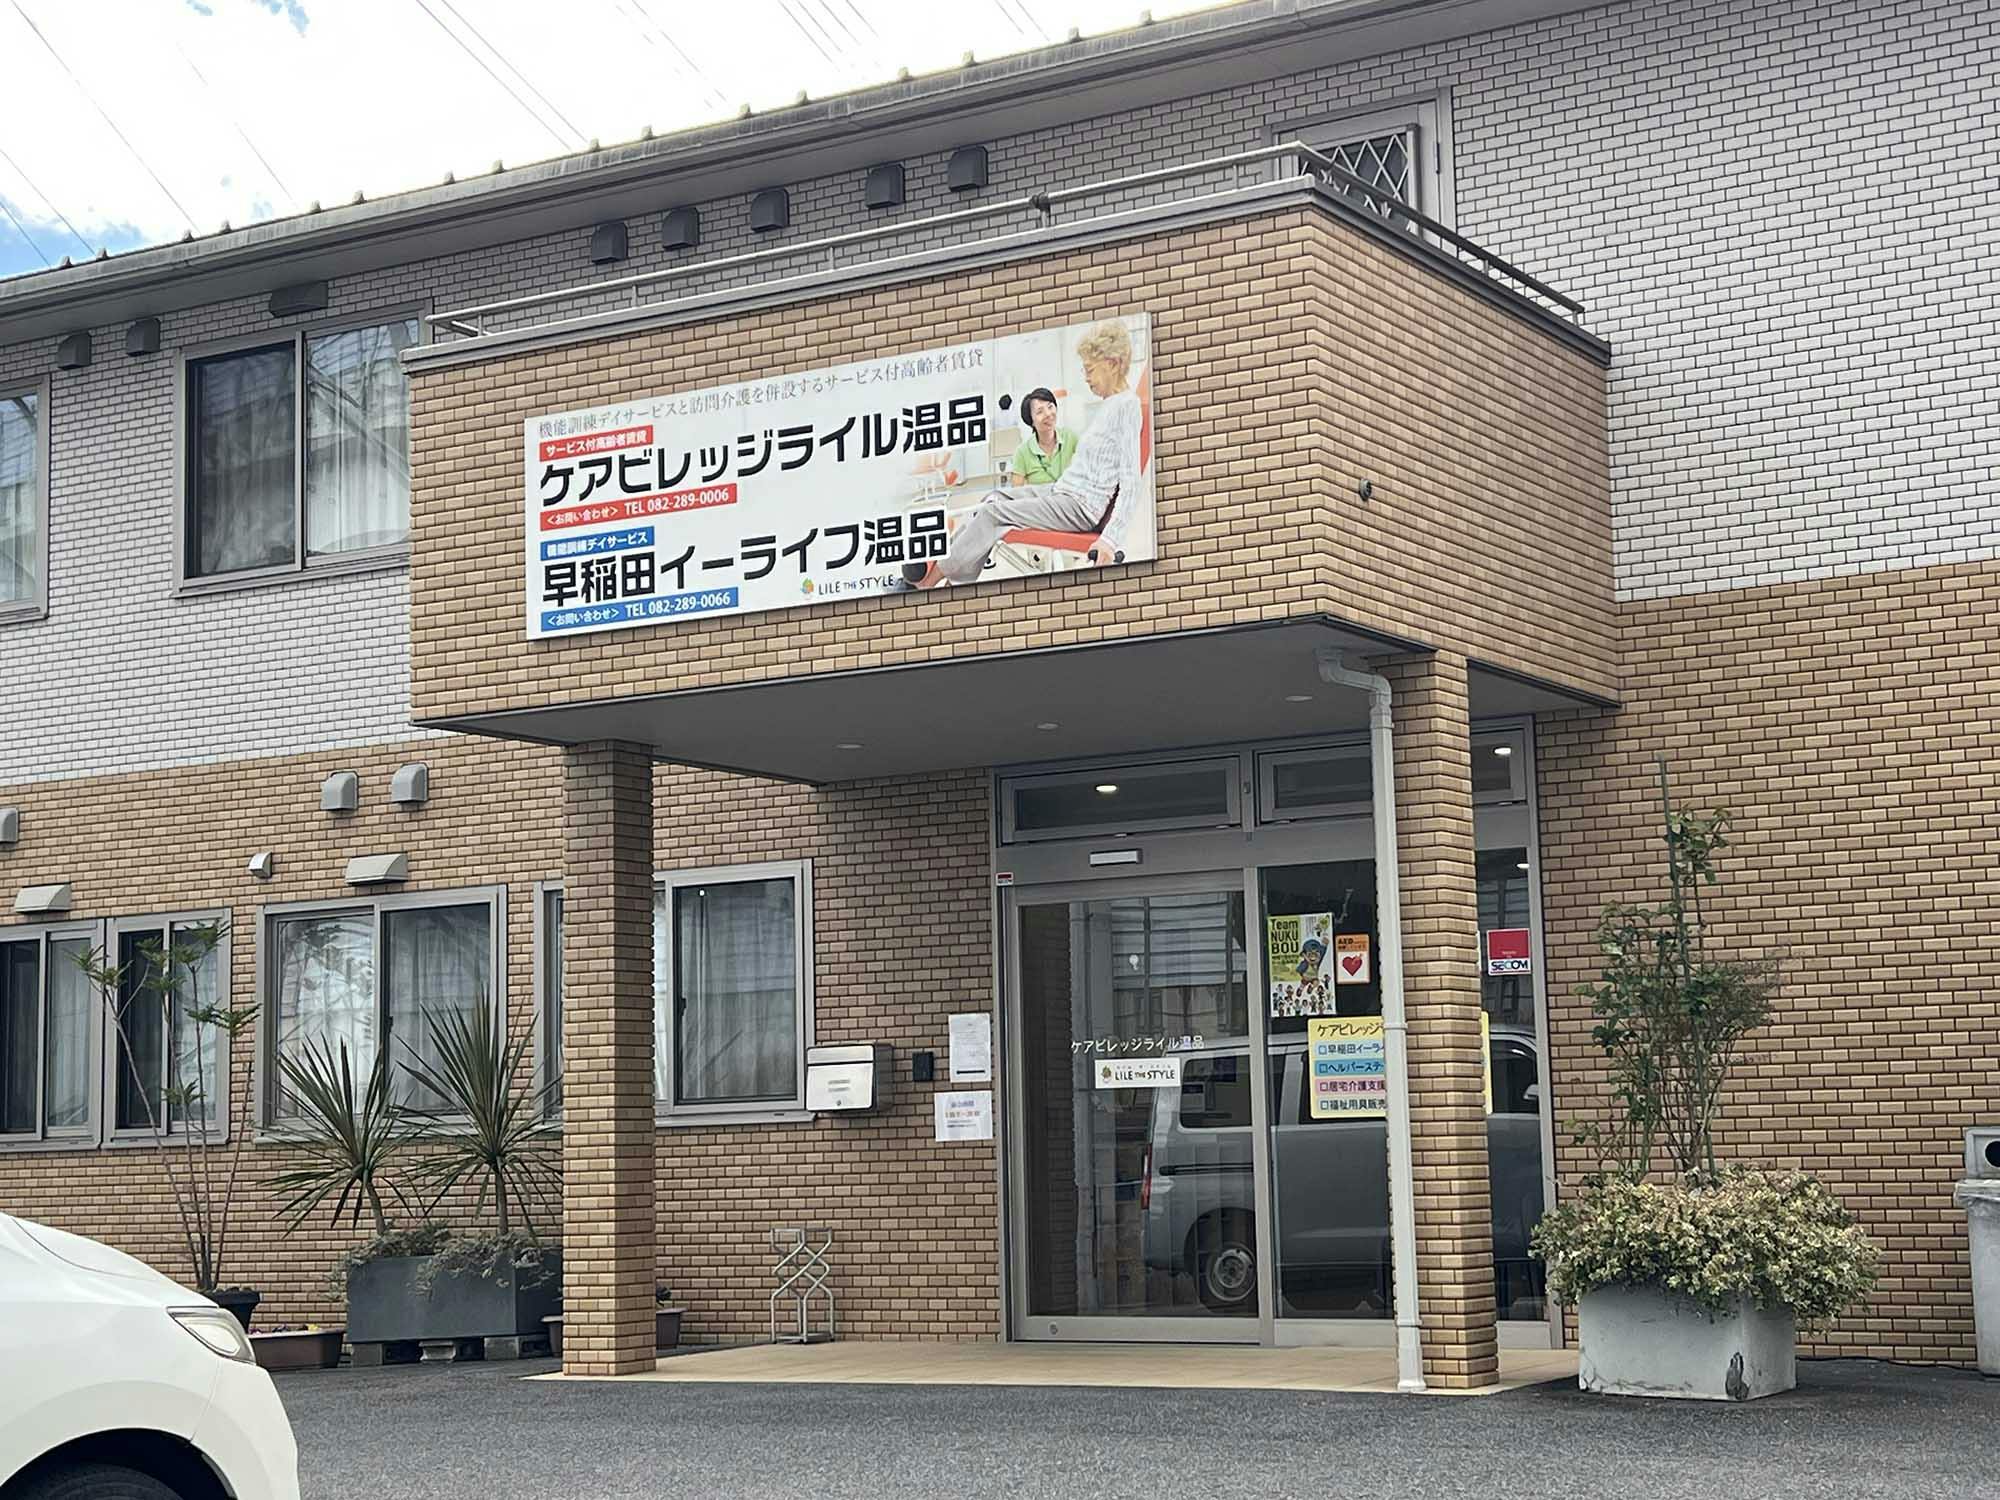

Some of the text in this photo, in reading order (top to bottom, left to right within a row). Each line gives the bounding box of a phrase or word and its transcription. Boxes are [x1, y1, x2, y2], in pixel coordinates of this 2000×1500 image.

[540, 395, 987, 507] ケアビレッジライル温品
[546, 430, 648, 458] サービス付高齢者賃貸
[625, 502, 644, 516] TEL
[647, 488, 729, 512] 082-289-0006
[546, 531, 648, 558] 機能訓練デイサービス
[543, 509, 947, 607] 早稲田イーライフ温品
[818, 574, 894, 596] LILE THE STYLE
[626, 603, 646, 617] TEL
[648, 592, 731, 616] 082-289-0066
[1271, 919, 1298, 930] Team
[1271, 930, 1299, 942] NUKU
[1271, 942, 1299, 954] BOU
[1491, 960, 1529, 971] SECOM
[1071, 1035, 1204, 1054] ケアビレッジライル温品
[1328, 1042, 1384, 1055] 早稲田イーラ
[1115, 1070, 1133, 1081] LILE
[1147, 1069, 1175, 1080] STYLE
